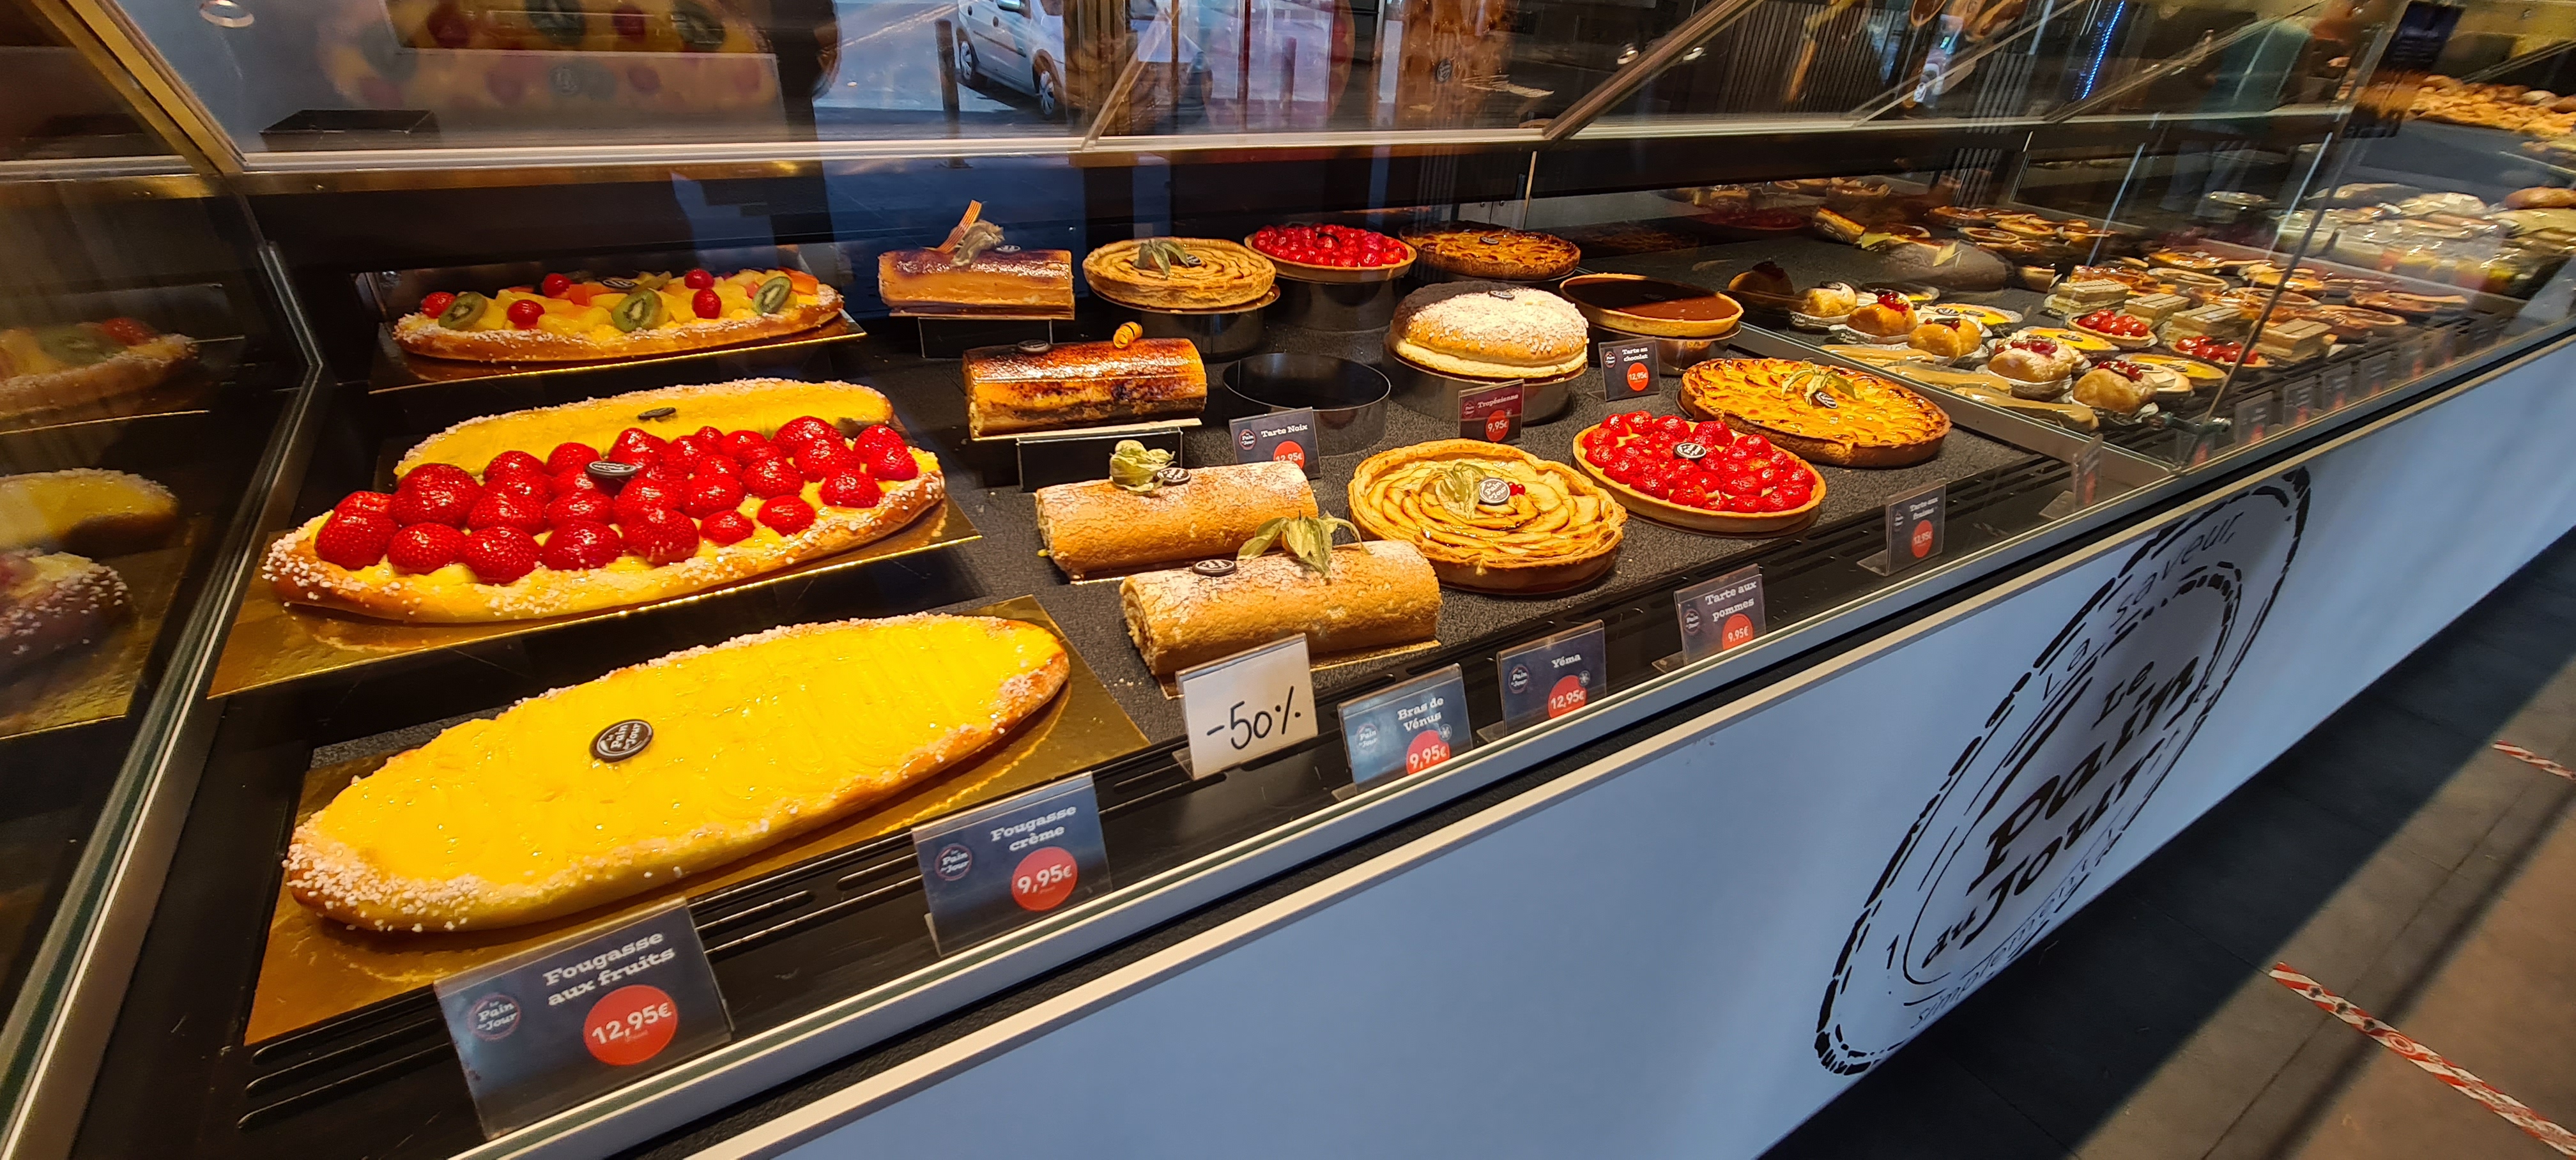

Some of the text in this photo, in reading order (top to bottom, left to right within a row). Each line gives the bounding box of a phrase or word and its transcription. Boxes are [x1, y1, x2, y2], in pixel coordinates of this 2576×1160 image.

[1623, 354, 1648, 362] chocolat
[1261, 424, 1308, 438] Tarte Noix
[1487, 419, 1508, 432] 9,95€
[1275, 452, 1303, 462] 1295€
[1705, 581, 1757, 606] Tarte aux
[2043, 511, 2244, 701] La saveur,
[1712, 597, 1754, 622] pommes
[1551, 653, 1582, 669] Yéma
[1551, 689, 1584, 710] 12,95€
[2090, 660, 2156, 731] Le
[1206, 685, 1301, 750] -50%
[1397, 697, 1444, 721] Bras de
[1403, 712, 1442, 732] Vénus
[610, 724, 629, 749] Pain
[1409, 744, 1447, 770] 9,95€
[1965, 656, 2200, 897] Pain
[990, 805, 1077, 842] Fougasse
[1009, 825, 1065, 851] crème
[1922, 737, 2166, 968] du Jour
[1016, 864, 1073, 895] 9,95€
[542, 932, 664, 986] Fougasse
[548, 948, 677, 1007] aux fruits
[477, 1003, 515, 1022] Pain
[486, 1012, 518, 1030] Jour
[592, 1002, 672, 1045] 12,95€
